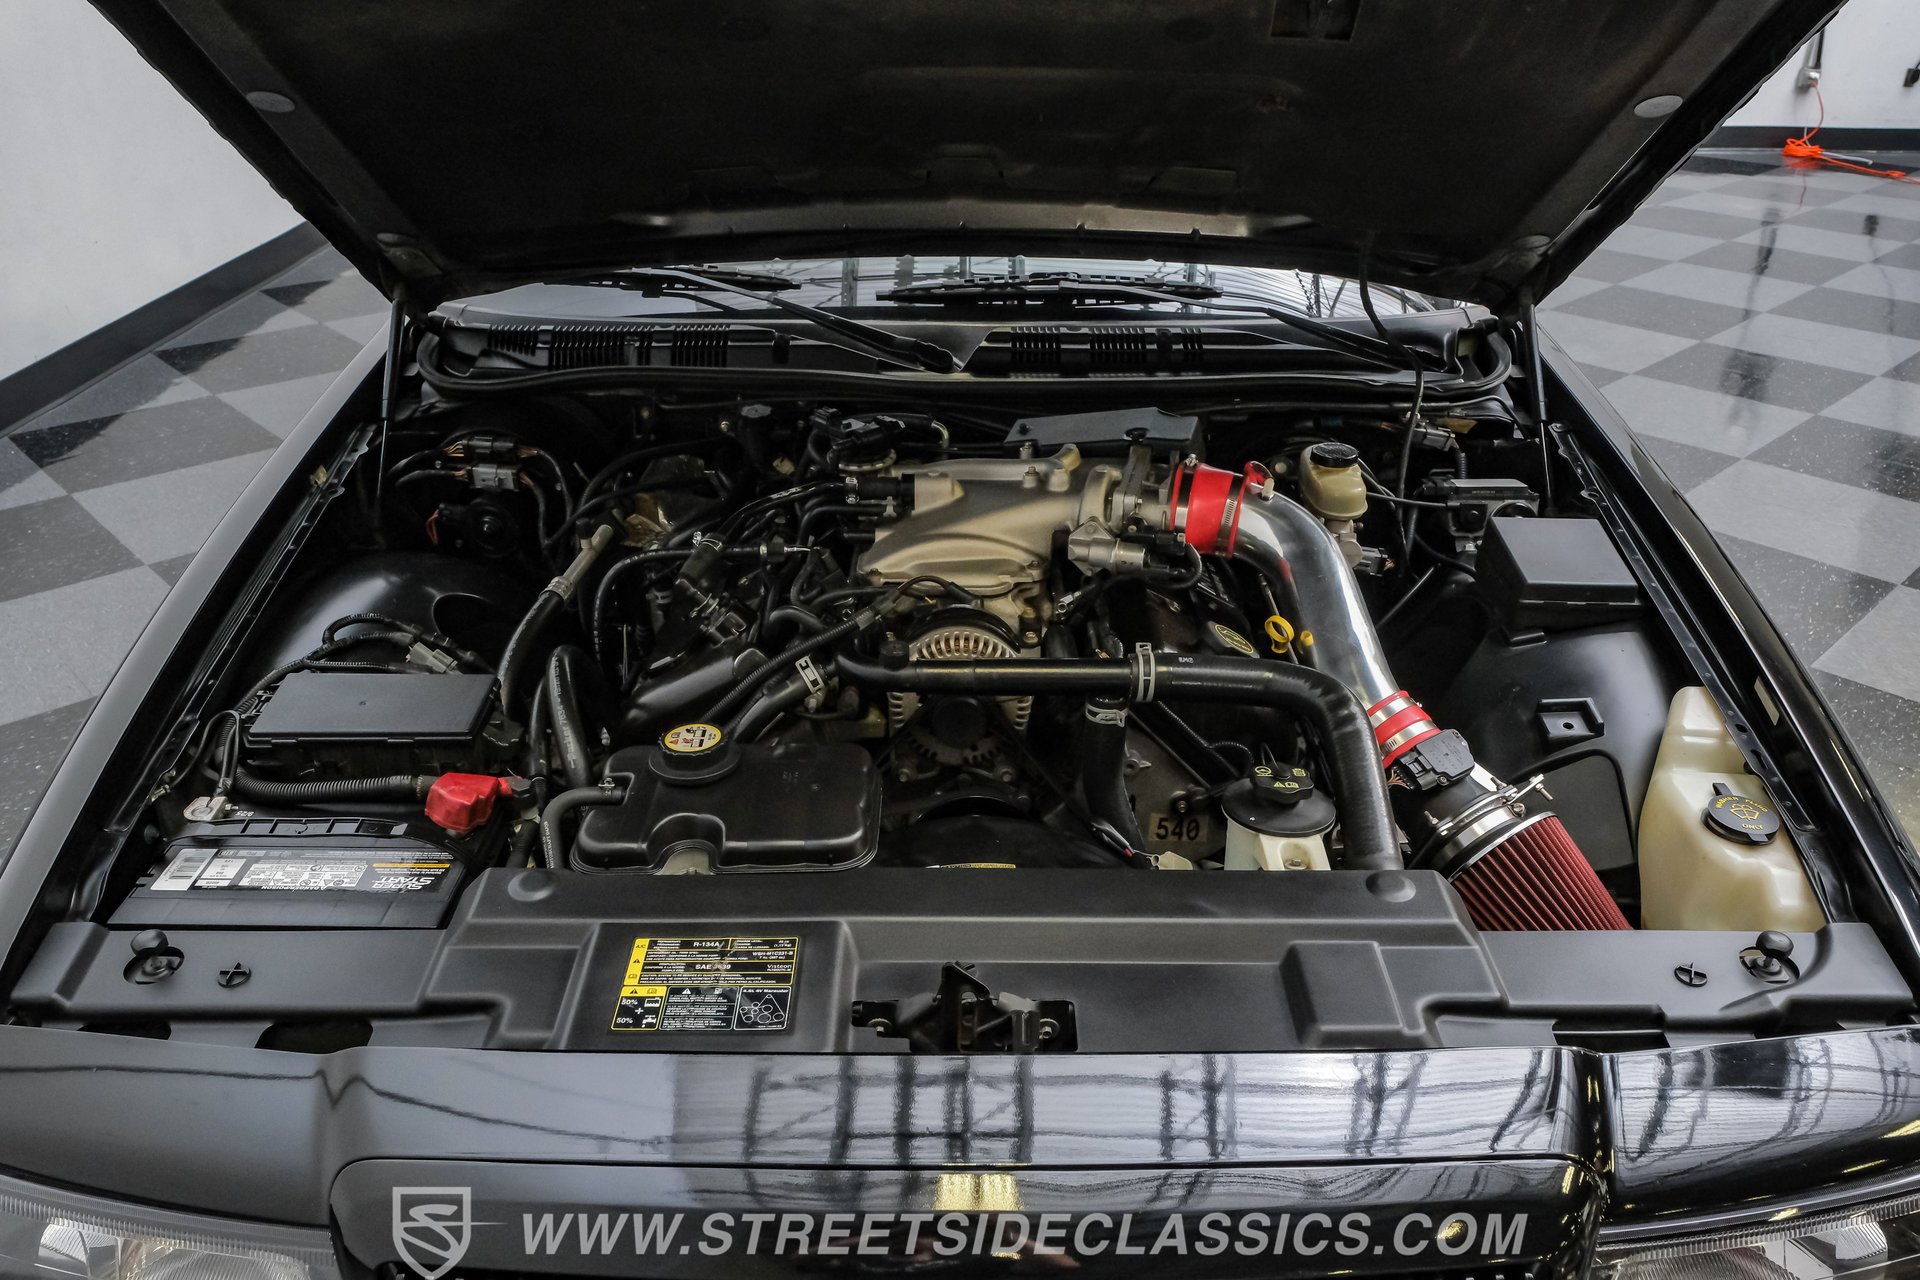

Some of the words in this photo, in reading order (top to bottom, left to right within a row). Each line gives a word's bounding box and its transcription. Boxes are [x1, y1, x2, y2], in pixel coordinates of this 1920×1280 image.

[1715, 797, 1739, 809] WASHER
[1745, 799, 1768, 812] FLUID
[1156, 817, 1200, 841] 540
[372, 881, 423, 890] SUPER
[381, 877, 435, 885] START
